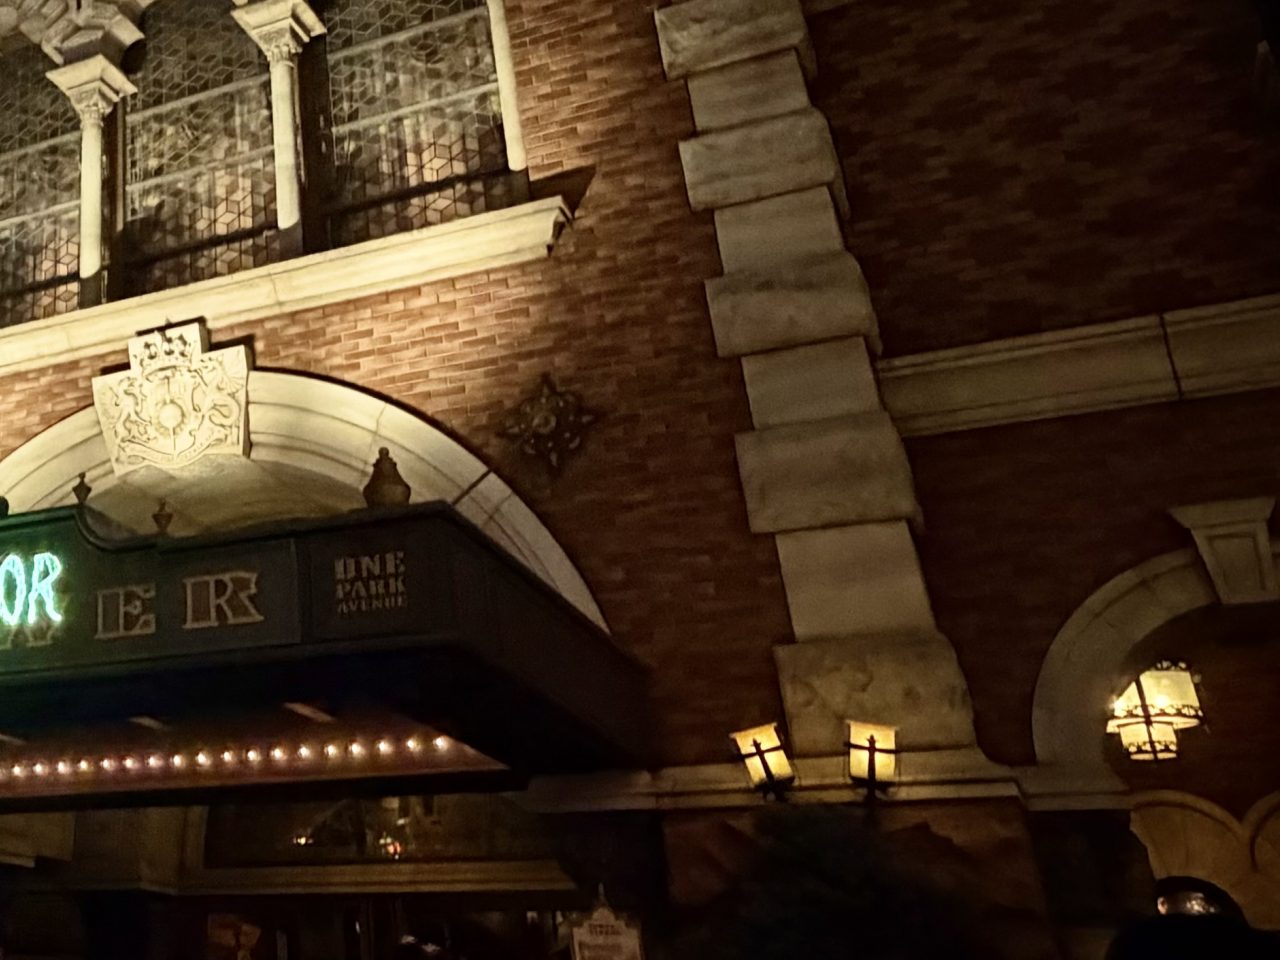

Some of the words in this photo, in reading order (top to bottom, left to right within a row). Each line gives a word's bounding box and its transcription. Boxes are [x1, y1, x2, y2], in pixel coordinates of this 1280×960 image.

[334, 550, 406, 580] ONE
[336, 576, 406, 600] PARK
[337, 595, 408, 615] AVENUE
